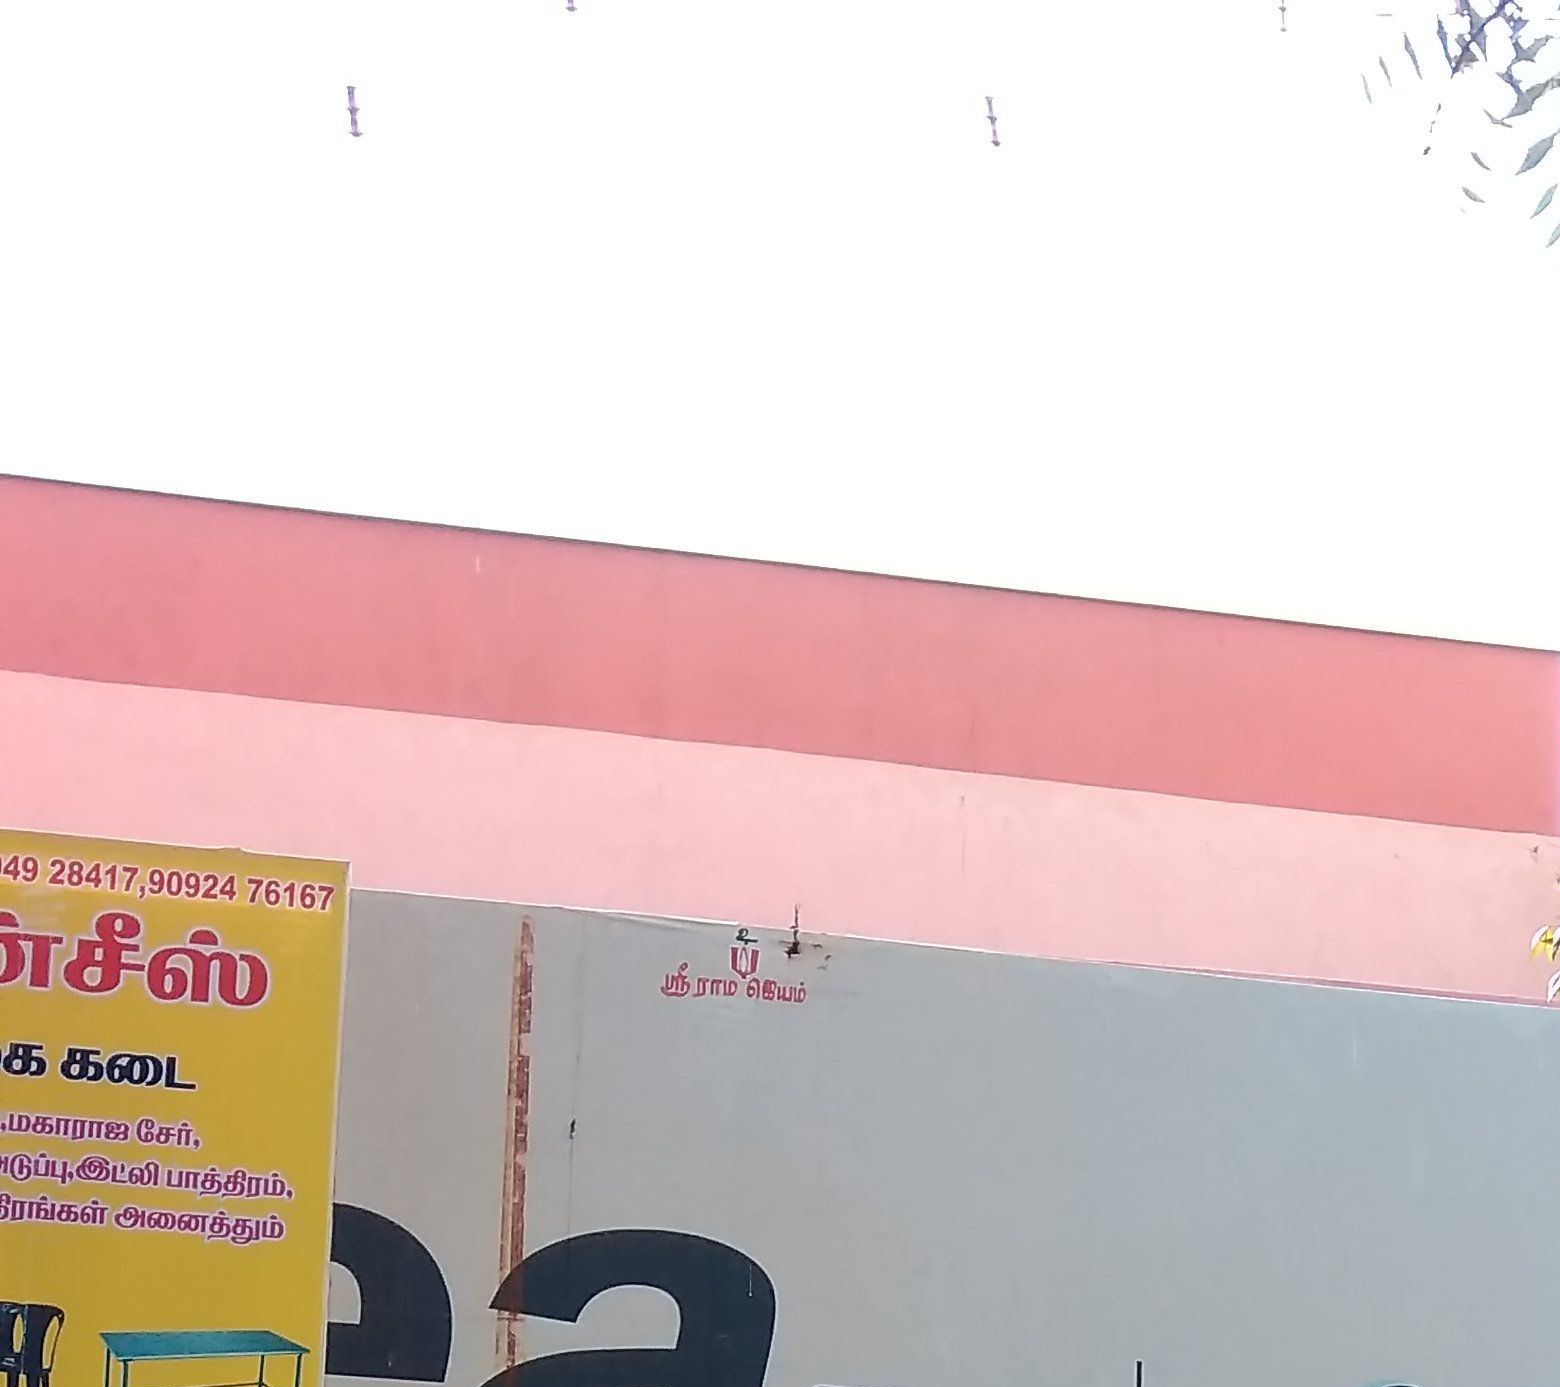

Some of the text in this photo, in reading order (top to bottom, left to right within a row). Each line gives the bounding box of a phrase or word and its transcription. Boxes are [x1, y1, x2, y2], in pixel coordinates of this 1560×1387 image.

[0, 855, 38, 882] 49
[247, 878, 335, 911] 76167
[61, 1046, 196, 1089] கடை
[114, 1206, 285, 1245] அனைத்தும்
